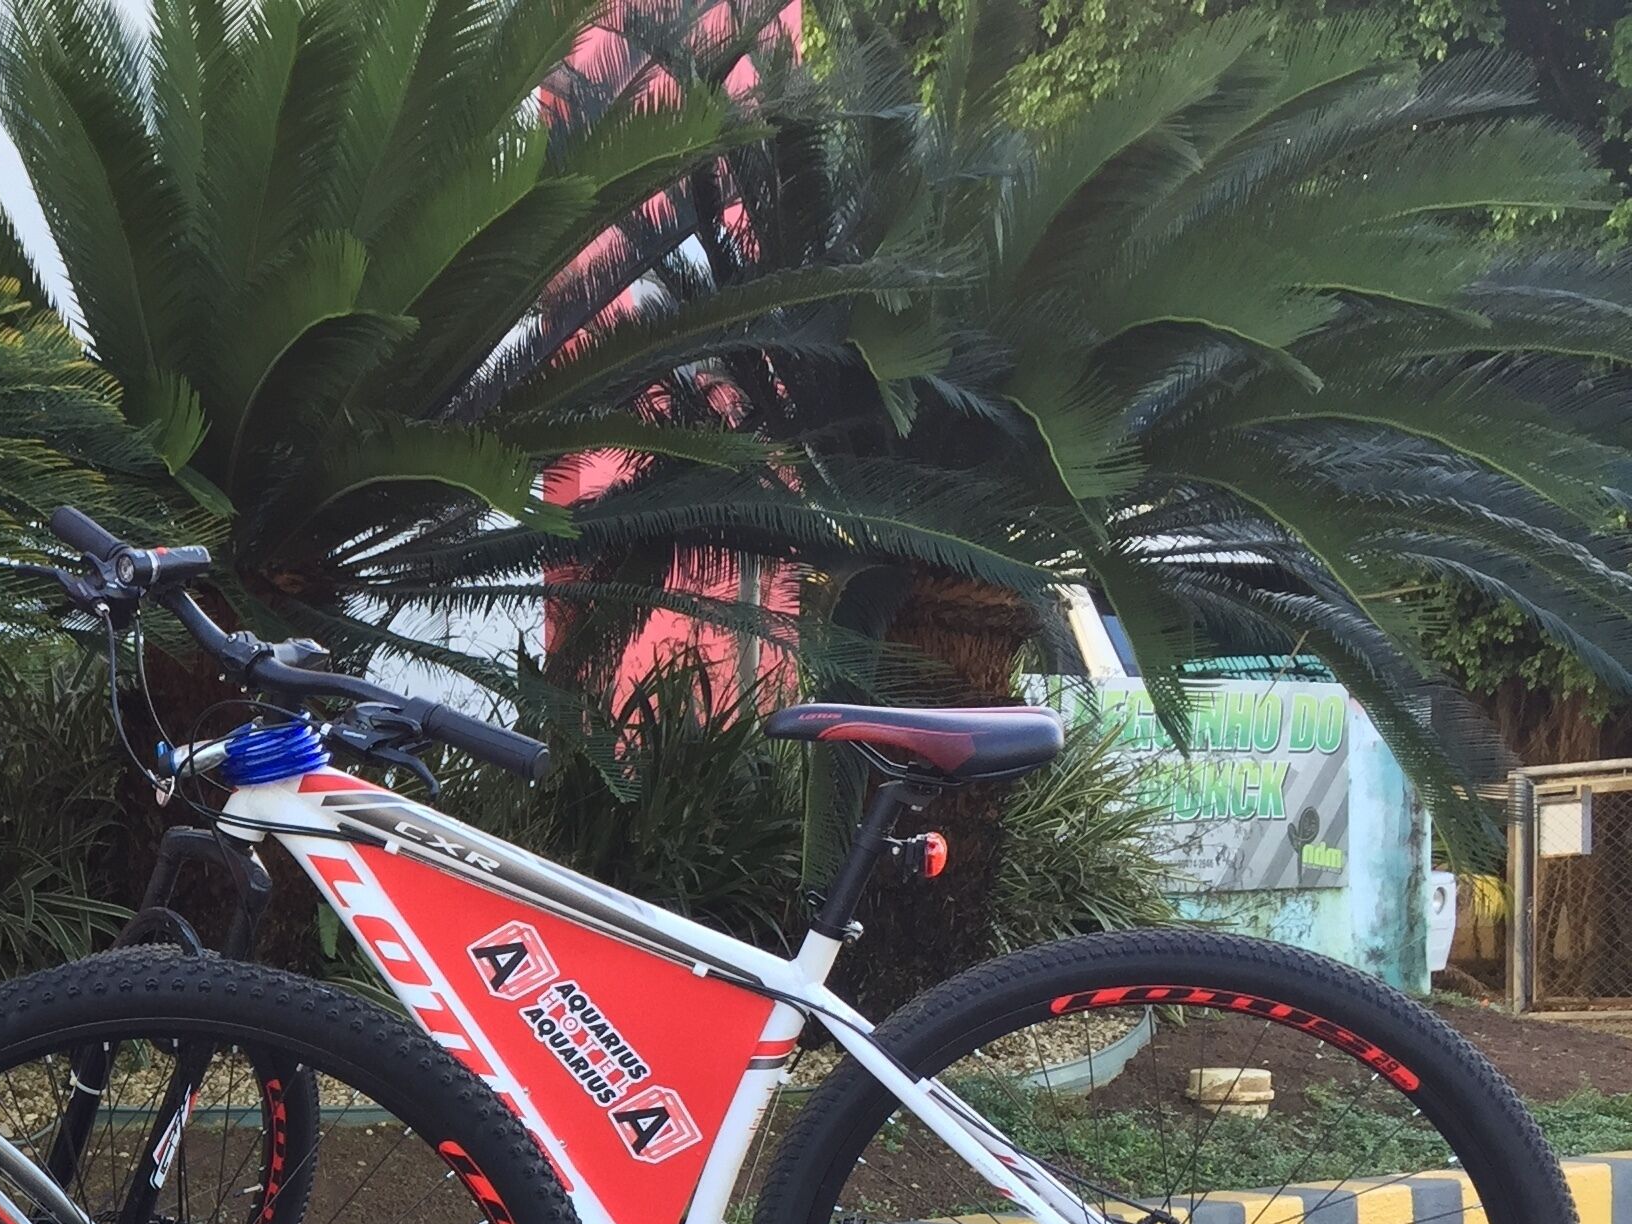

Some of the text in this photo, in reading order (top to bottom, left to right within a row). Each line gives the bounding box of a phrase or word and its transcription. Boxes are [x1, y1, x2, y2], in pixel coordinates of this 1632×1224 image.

[1288, 693, 1345, 753] DO
[394, 821, 500, 873] CXR
[523, 1008, 617, 1104] AQUARIUS
[540, 991, 630, 1093] HOTEL
[554, 984, 648, 1080] AQUARIUS
